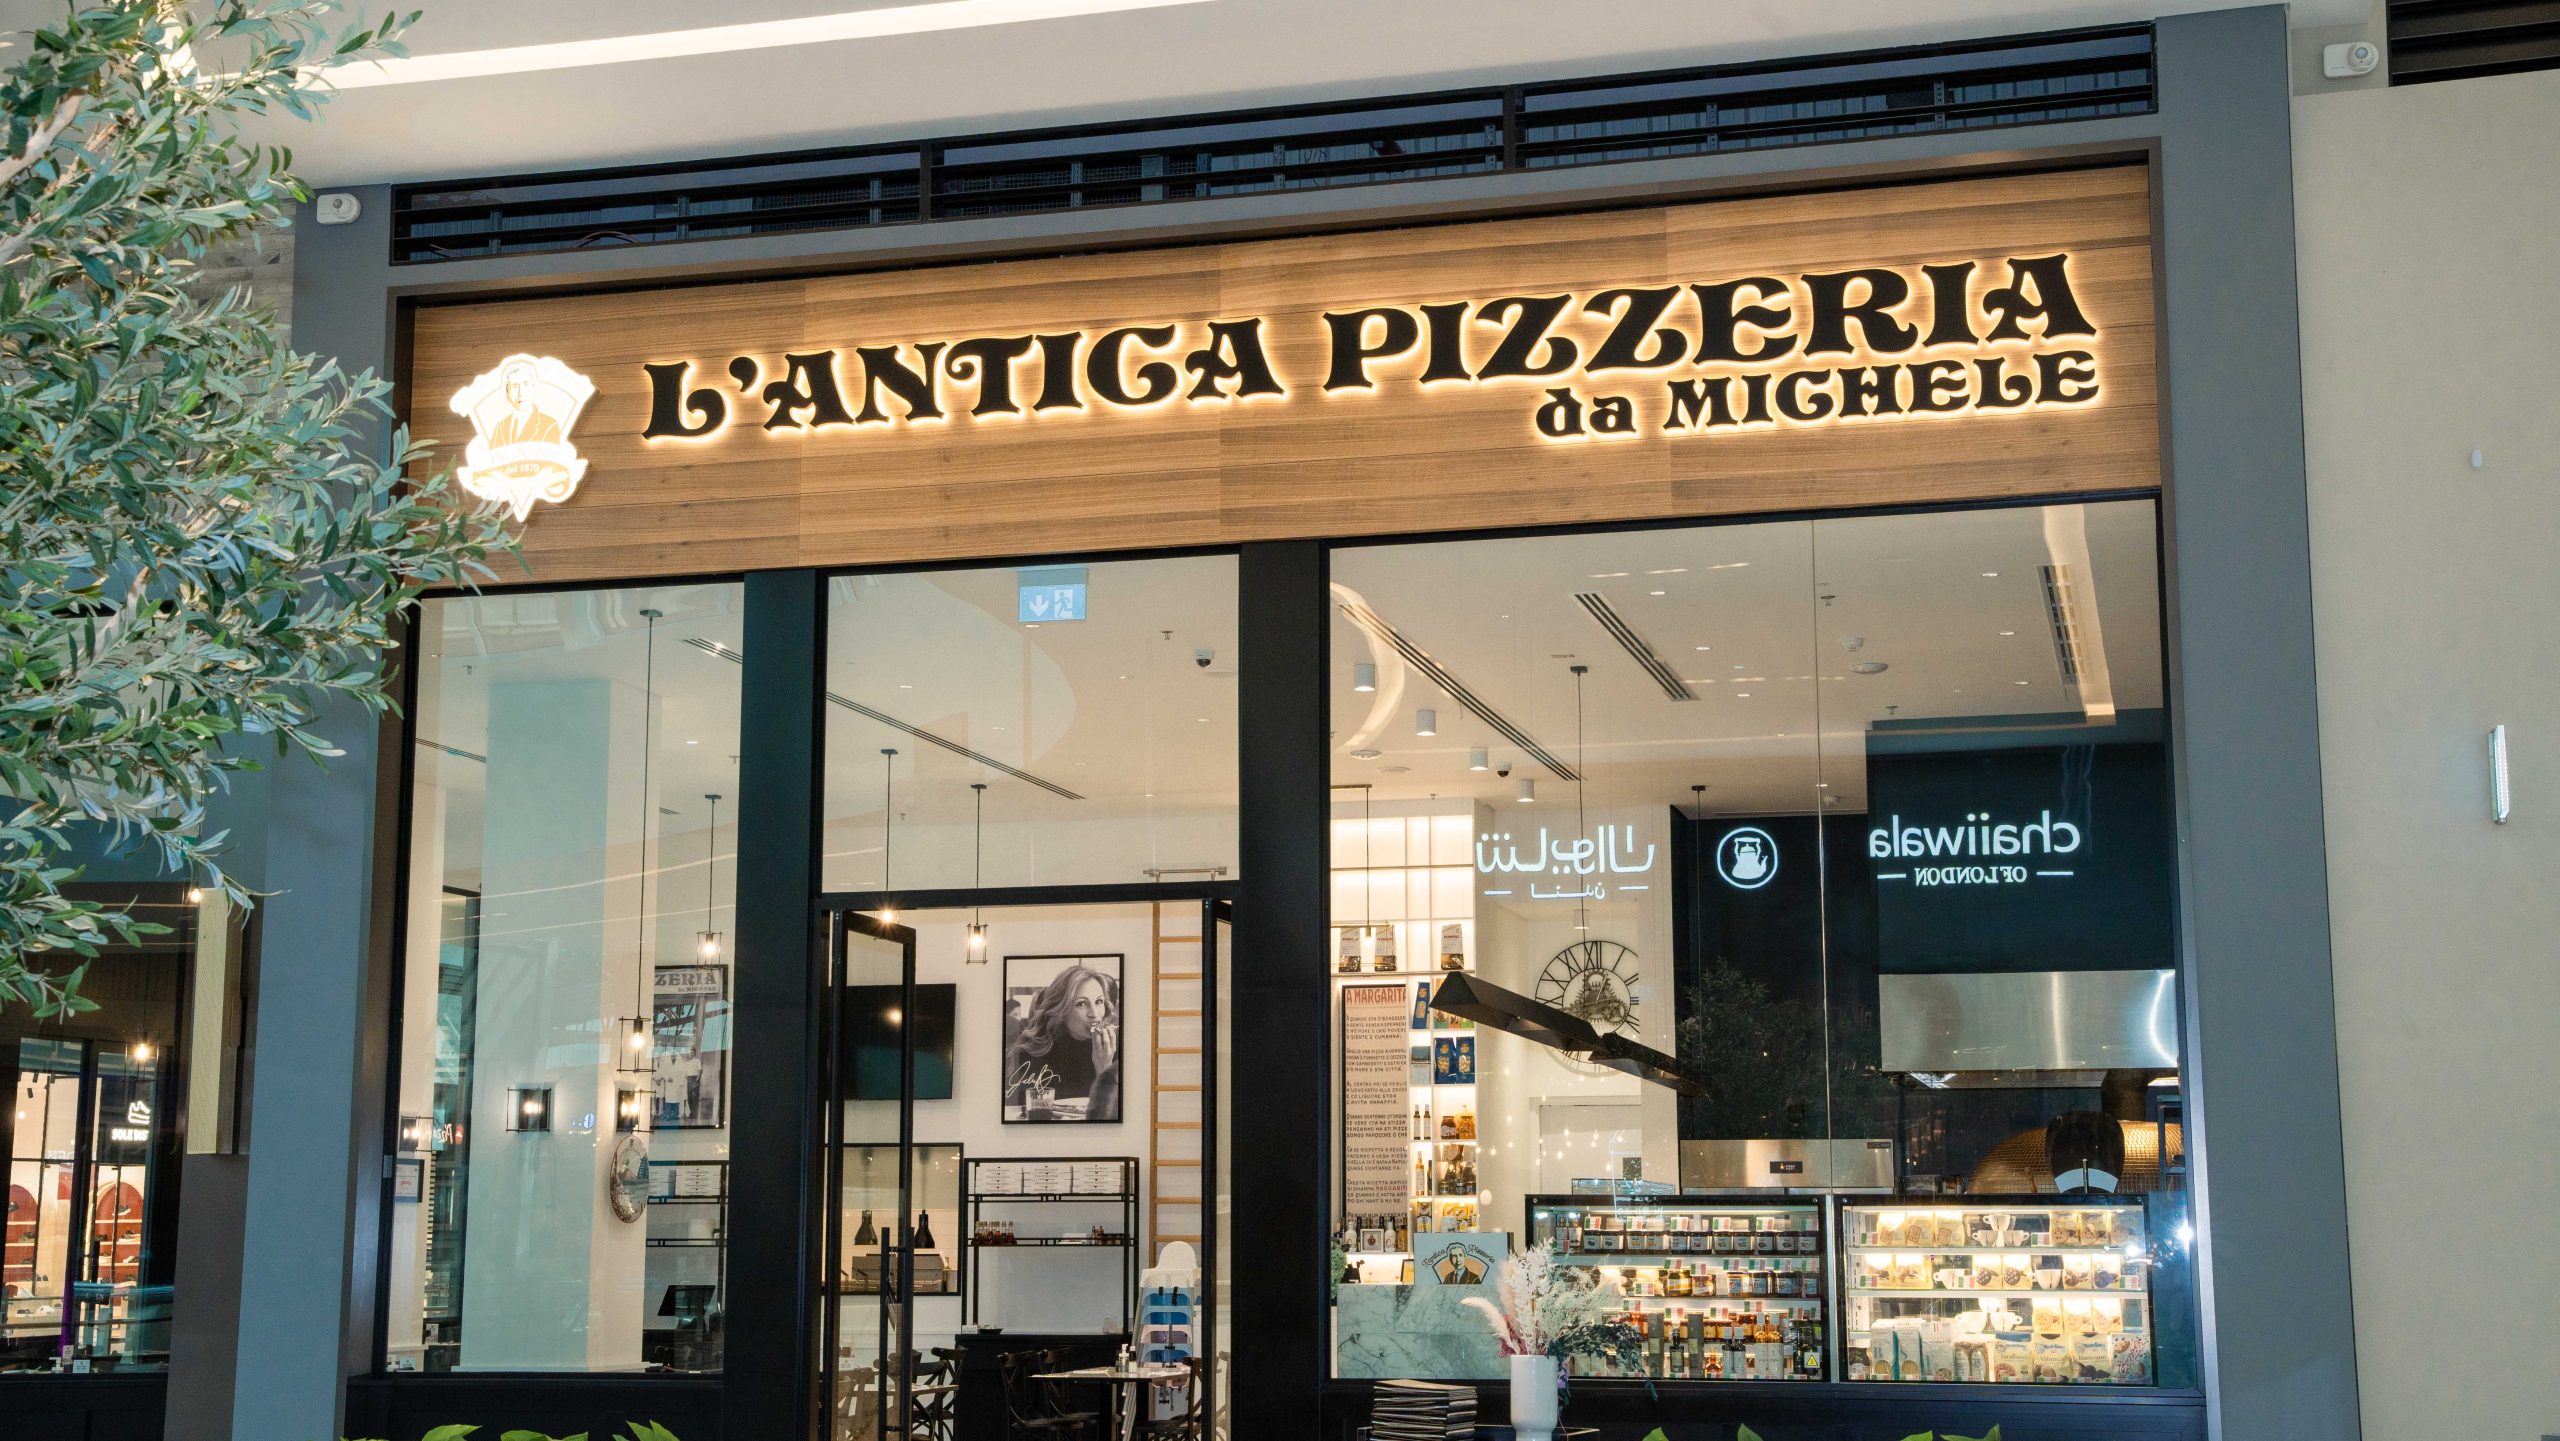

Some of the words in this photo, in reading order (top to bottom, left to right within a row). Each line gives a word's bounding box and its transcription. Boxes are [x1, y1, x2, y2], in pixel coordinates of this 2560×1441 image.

[641, 316, 1285, 441] L'ANTICA
[1322, 252, 2098, 393] PIZZERIA
[1534, 388, 1639, 440] da
[1662, 349, 2101, 432] MICHELE
